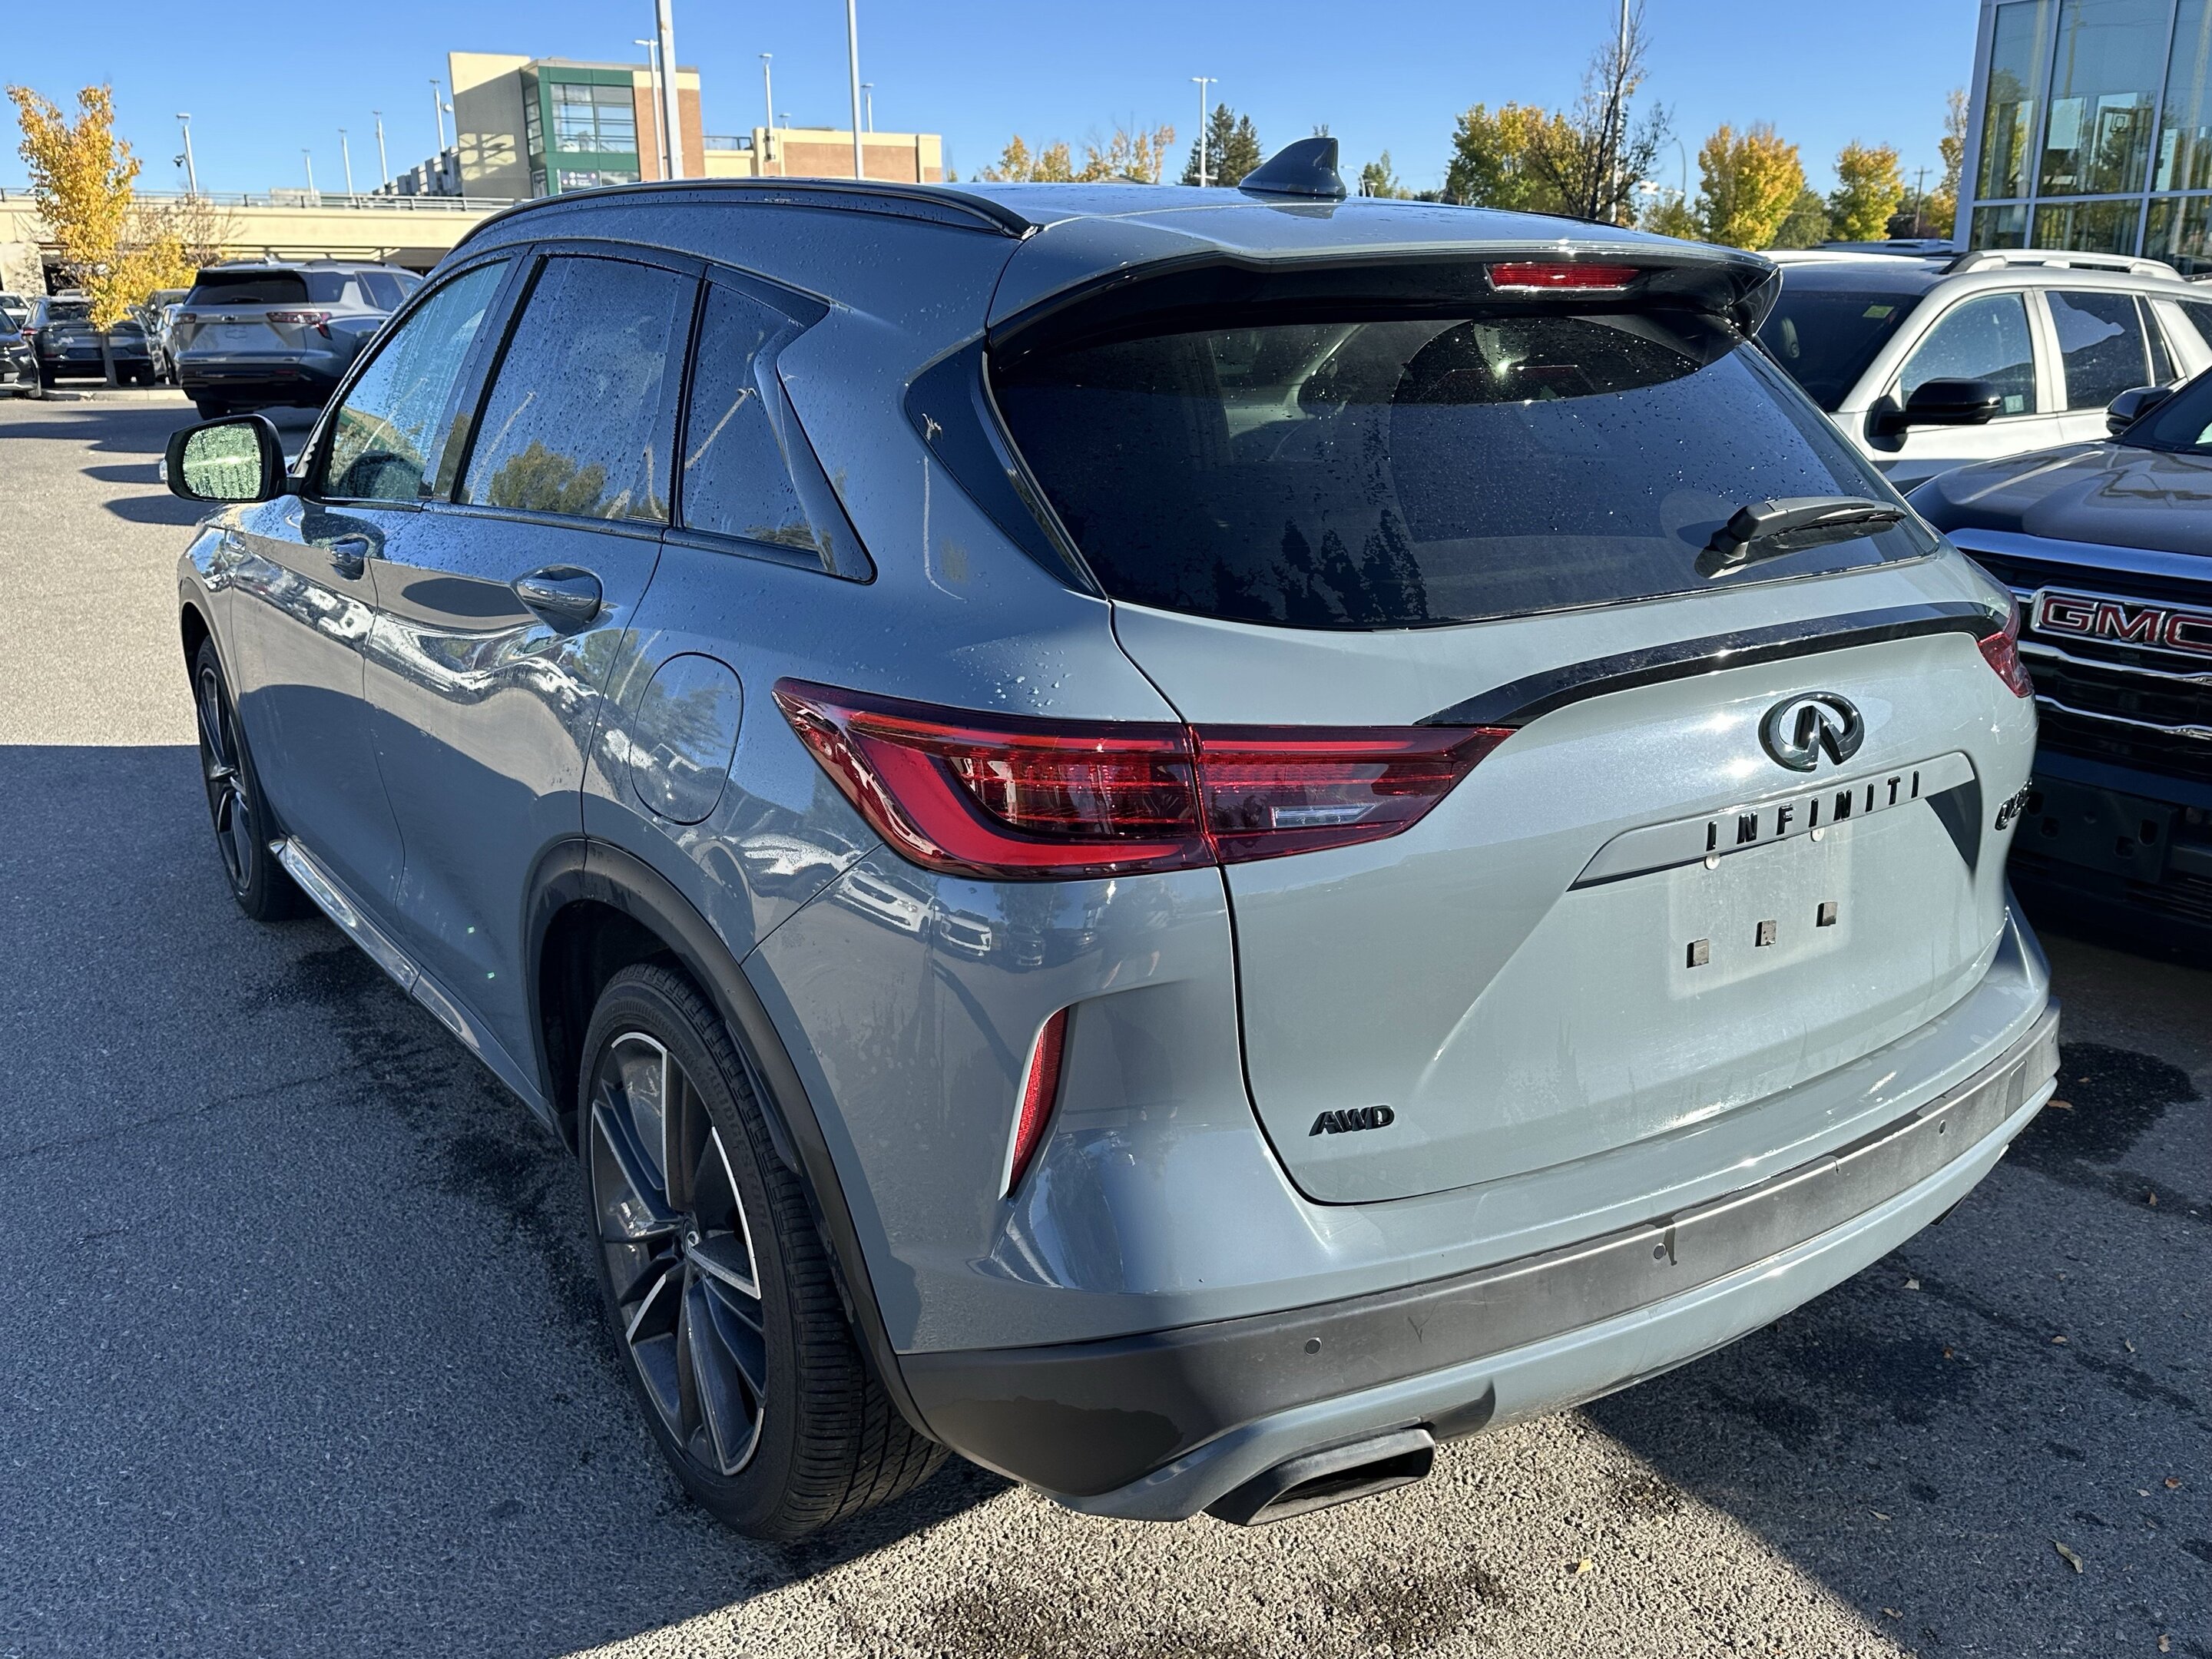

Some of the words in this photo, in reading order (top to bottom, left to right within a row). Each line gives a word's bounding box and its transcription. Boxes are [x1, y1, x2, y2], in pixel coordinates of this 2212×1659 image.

[2040, 594, 2212, 652] GMC
[1705, 770, 1920, 852] INFINITI
[1308, 1104, 1396, 1137] AWD
